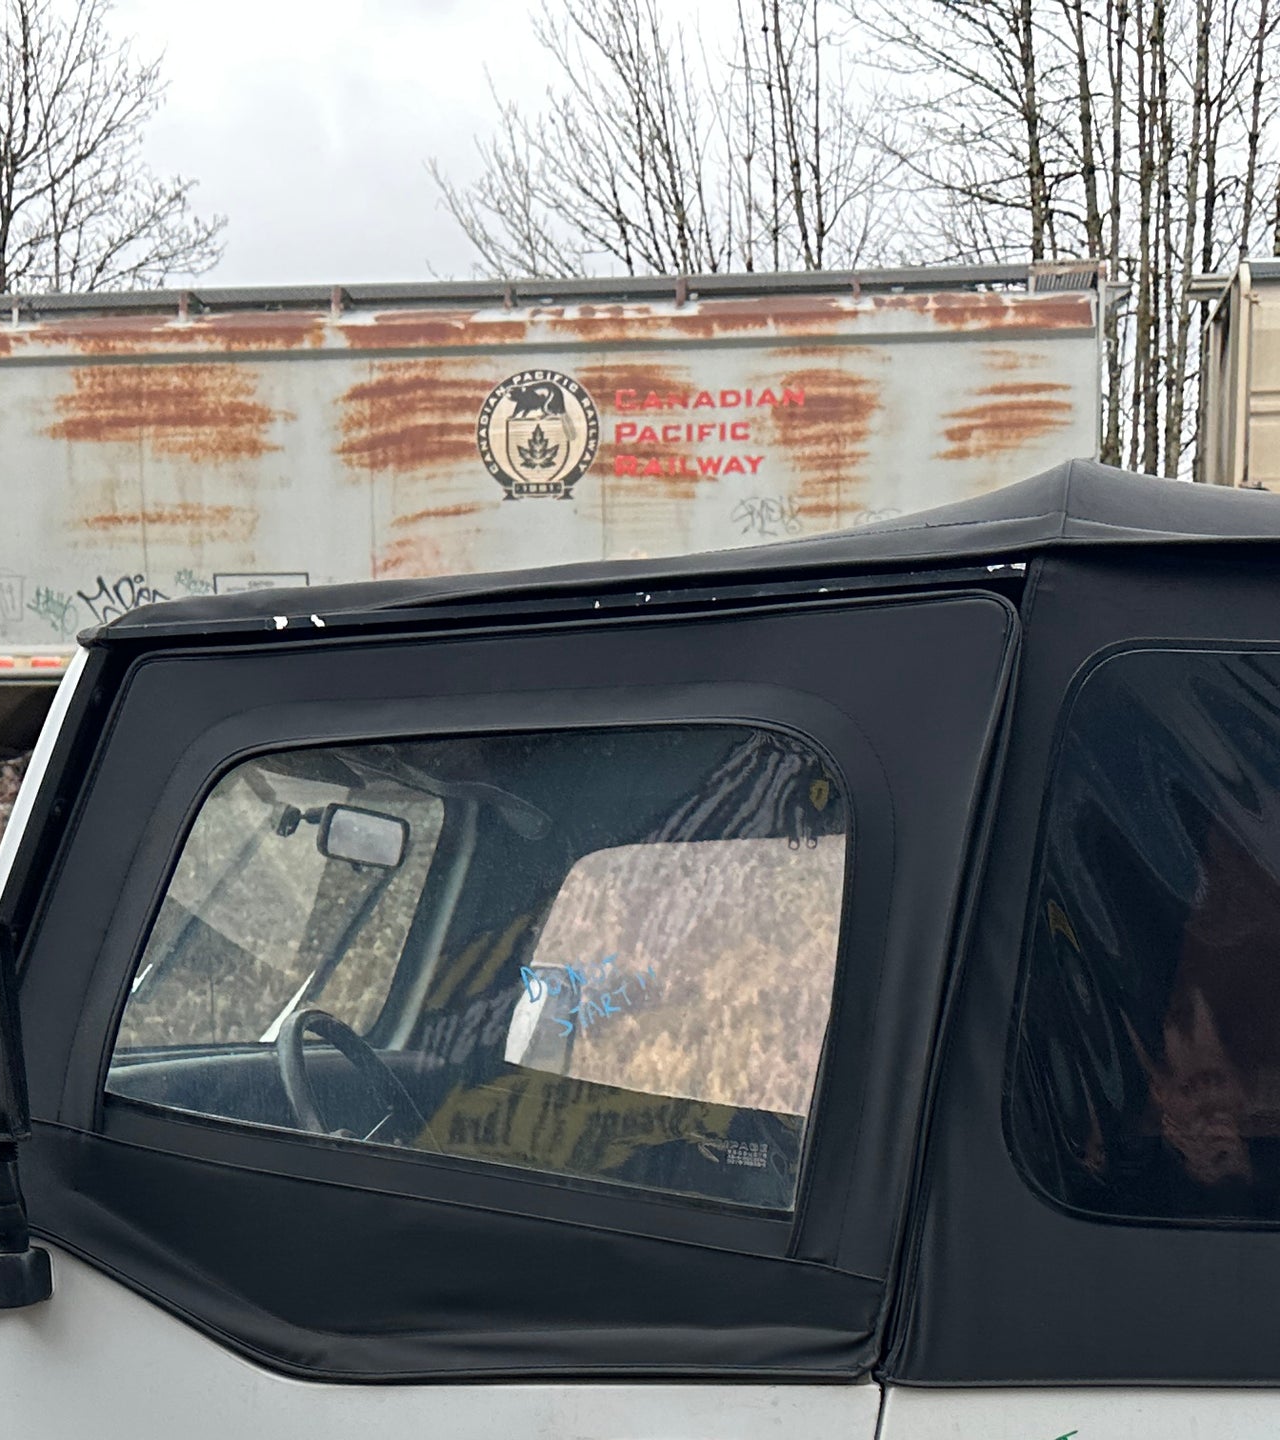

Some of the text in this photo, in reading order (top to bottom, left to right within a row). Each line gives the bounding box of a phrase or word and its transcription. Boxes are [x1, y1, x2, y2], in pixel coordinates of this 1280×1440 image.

[614, 387, 806, 412] CANADIAN
[479, 371, 598, 475] CANADIAN PACIFIC RAILWAY
[614, 421, 751, 446] PACIFIC
[613, 454, 765, 477] RAILWAY
